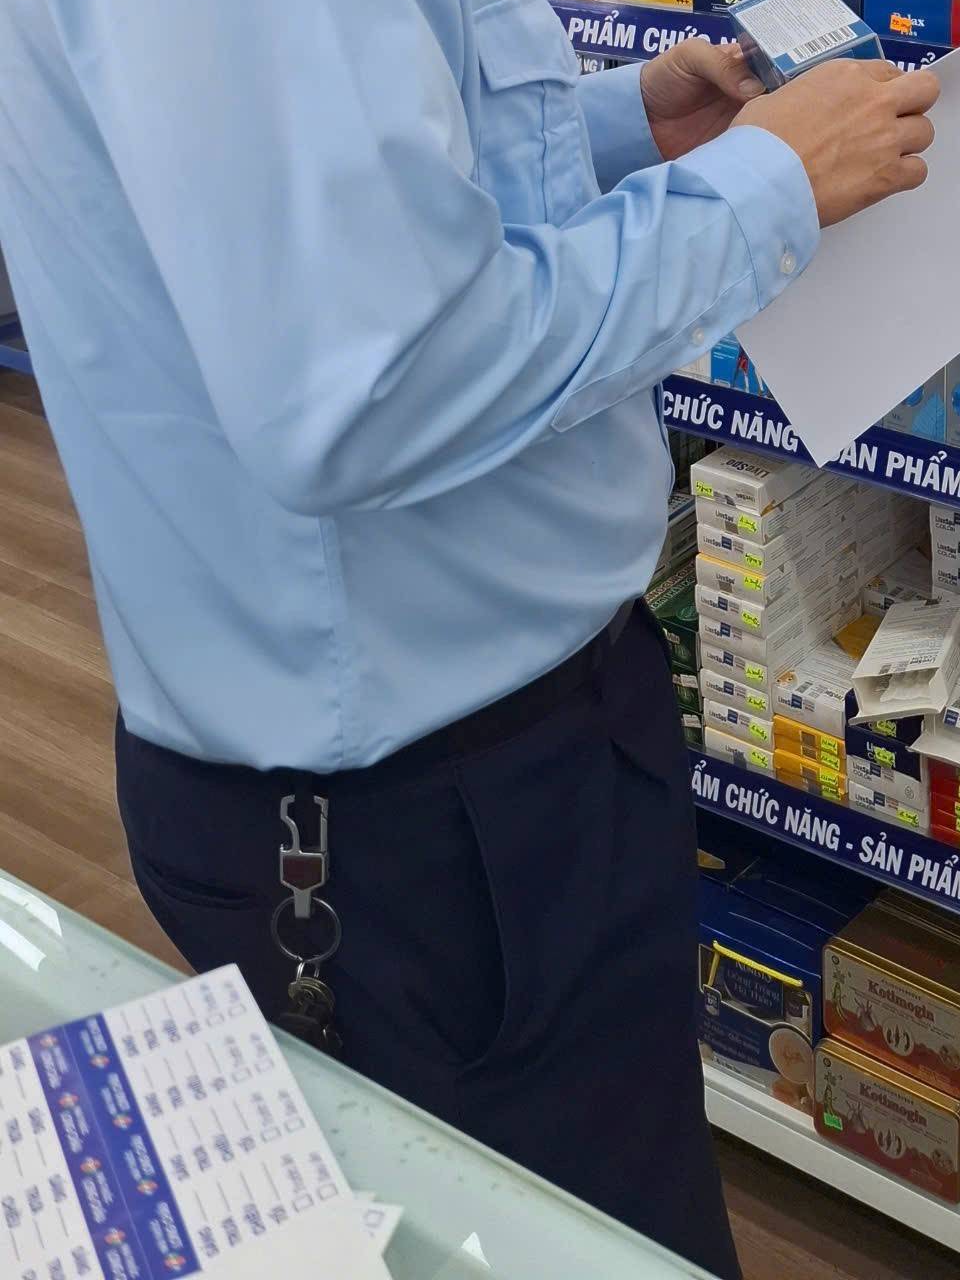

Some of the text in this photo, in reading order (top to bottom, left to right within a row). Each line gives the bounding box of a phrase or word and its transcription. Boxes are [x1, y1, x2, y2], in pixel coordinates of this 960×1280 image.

[567, 11, 635, 48] PHẨM
[662, 391, 724, 430] CHỨC
[730, 411, 798, 452] NĂNG
[725, 780, 780, 825] CHỨC
[783, 807, 842, 852] NĂNG
[858, 833, 903, 877] SẢN
